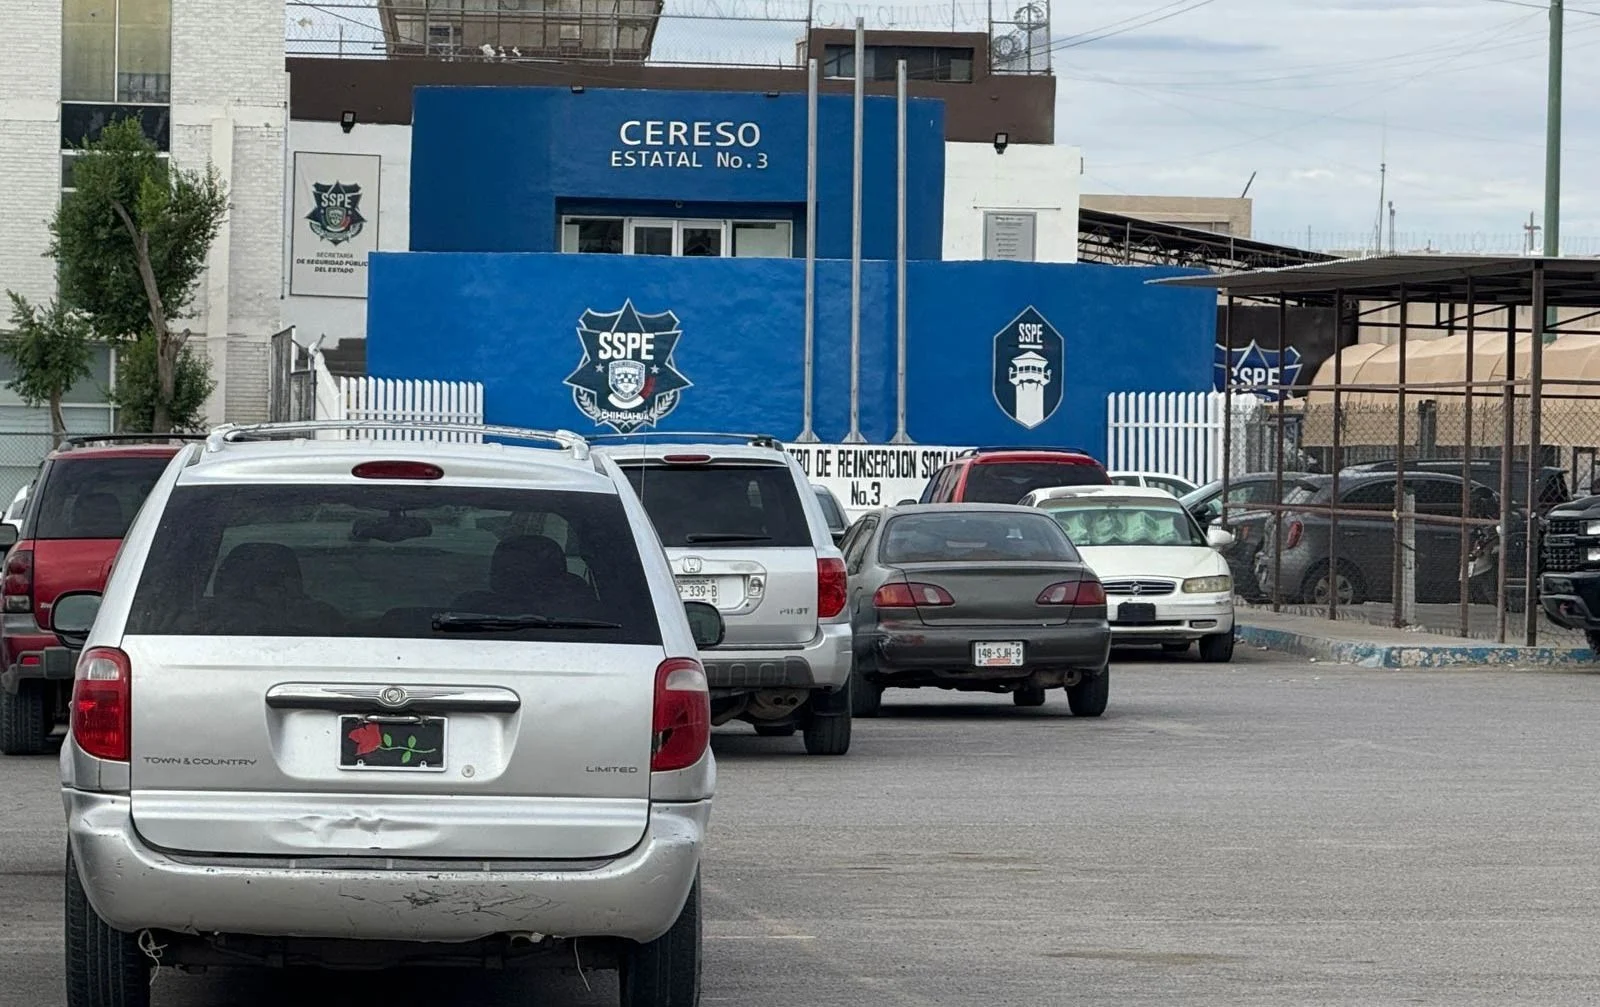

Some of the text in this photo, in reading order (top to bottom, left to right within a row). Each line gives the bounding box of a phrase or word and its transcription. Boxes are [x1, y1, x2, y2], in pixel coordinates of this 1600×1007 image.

[620, 120, 761, 147] CERESO
[611, 151, 703, 167] ESTATAL
[321, 193, 352, 208] SSPE
[1018, 323, 1043, 344] SSPE
[598, 332, 655, 360] SSPE
[601, 411, 650, 421] CHIHUAHUA
[816, 450, 831, 477] DE
[838, 449, 917, 478] REINSERCION
[851, 481, 881, 506] No.3
[143, 756, 257, 766] TOWN & COUNTRY
